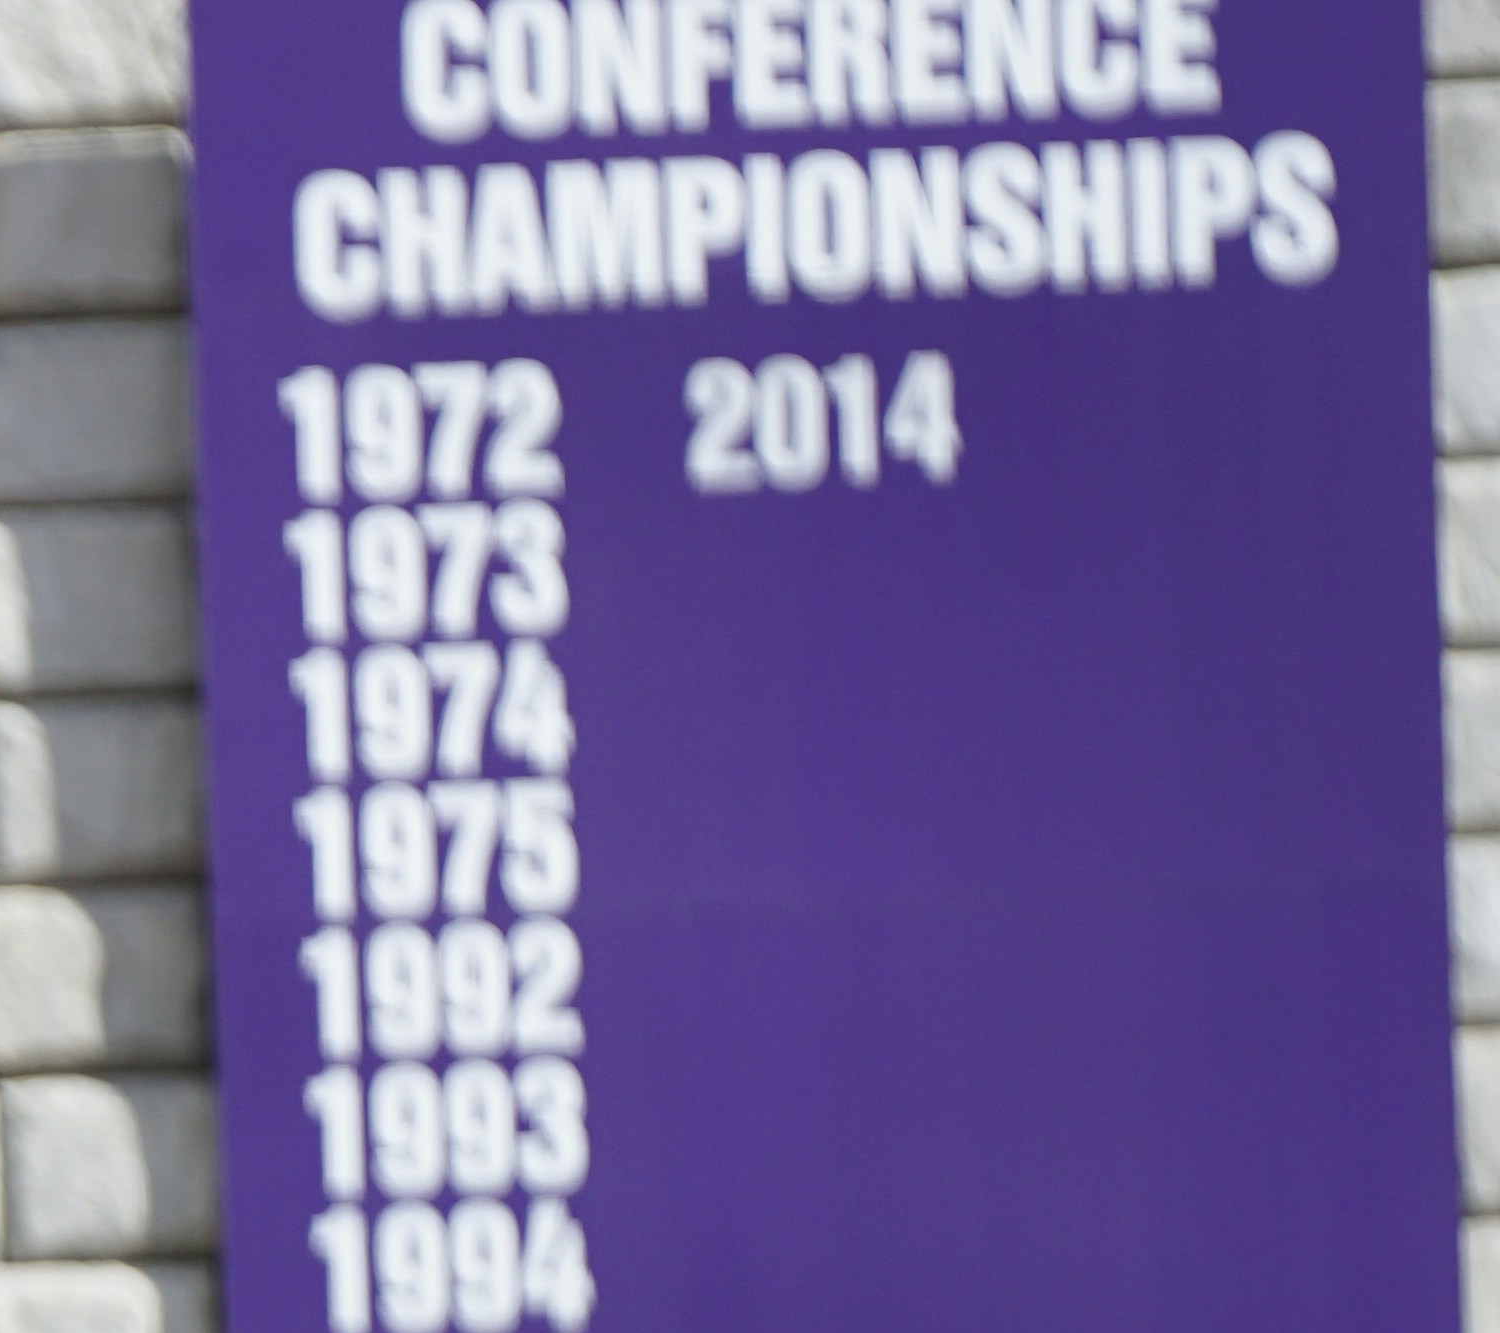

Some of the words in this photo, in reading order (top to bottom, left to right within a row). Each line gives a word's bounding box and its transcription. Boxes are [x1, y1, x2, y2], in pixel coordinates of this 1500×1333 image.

[402, 0, 1222, 142] CONFERENCE
[294, 130, 1337, 320] CHAMPIONSHIPS
[279, 359, 564, 503] 1972
[687, 351, 961, 491] 2014
[285, 500, 570, 645] 1973
[290, 640, 575, 782] 1974
[295, 781, 581, 921] 1975
[301, 916, 585, 1062] 1992
[305, 1056, 590, 1198] 1993
